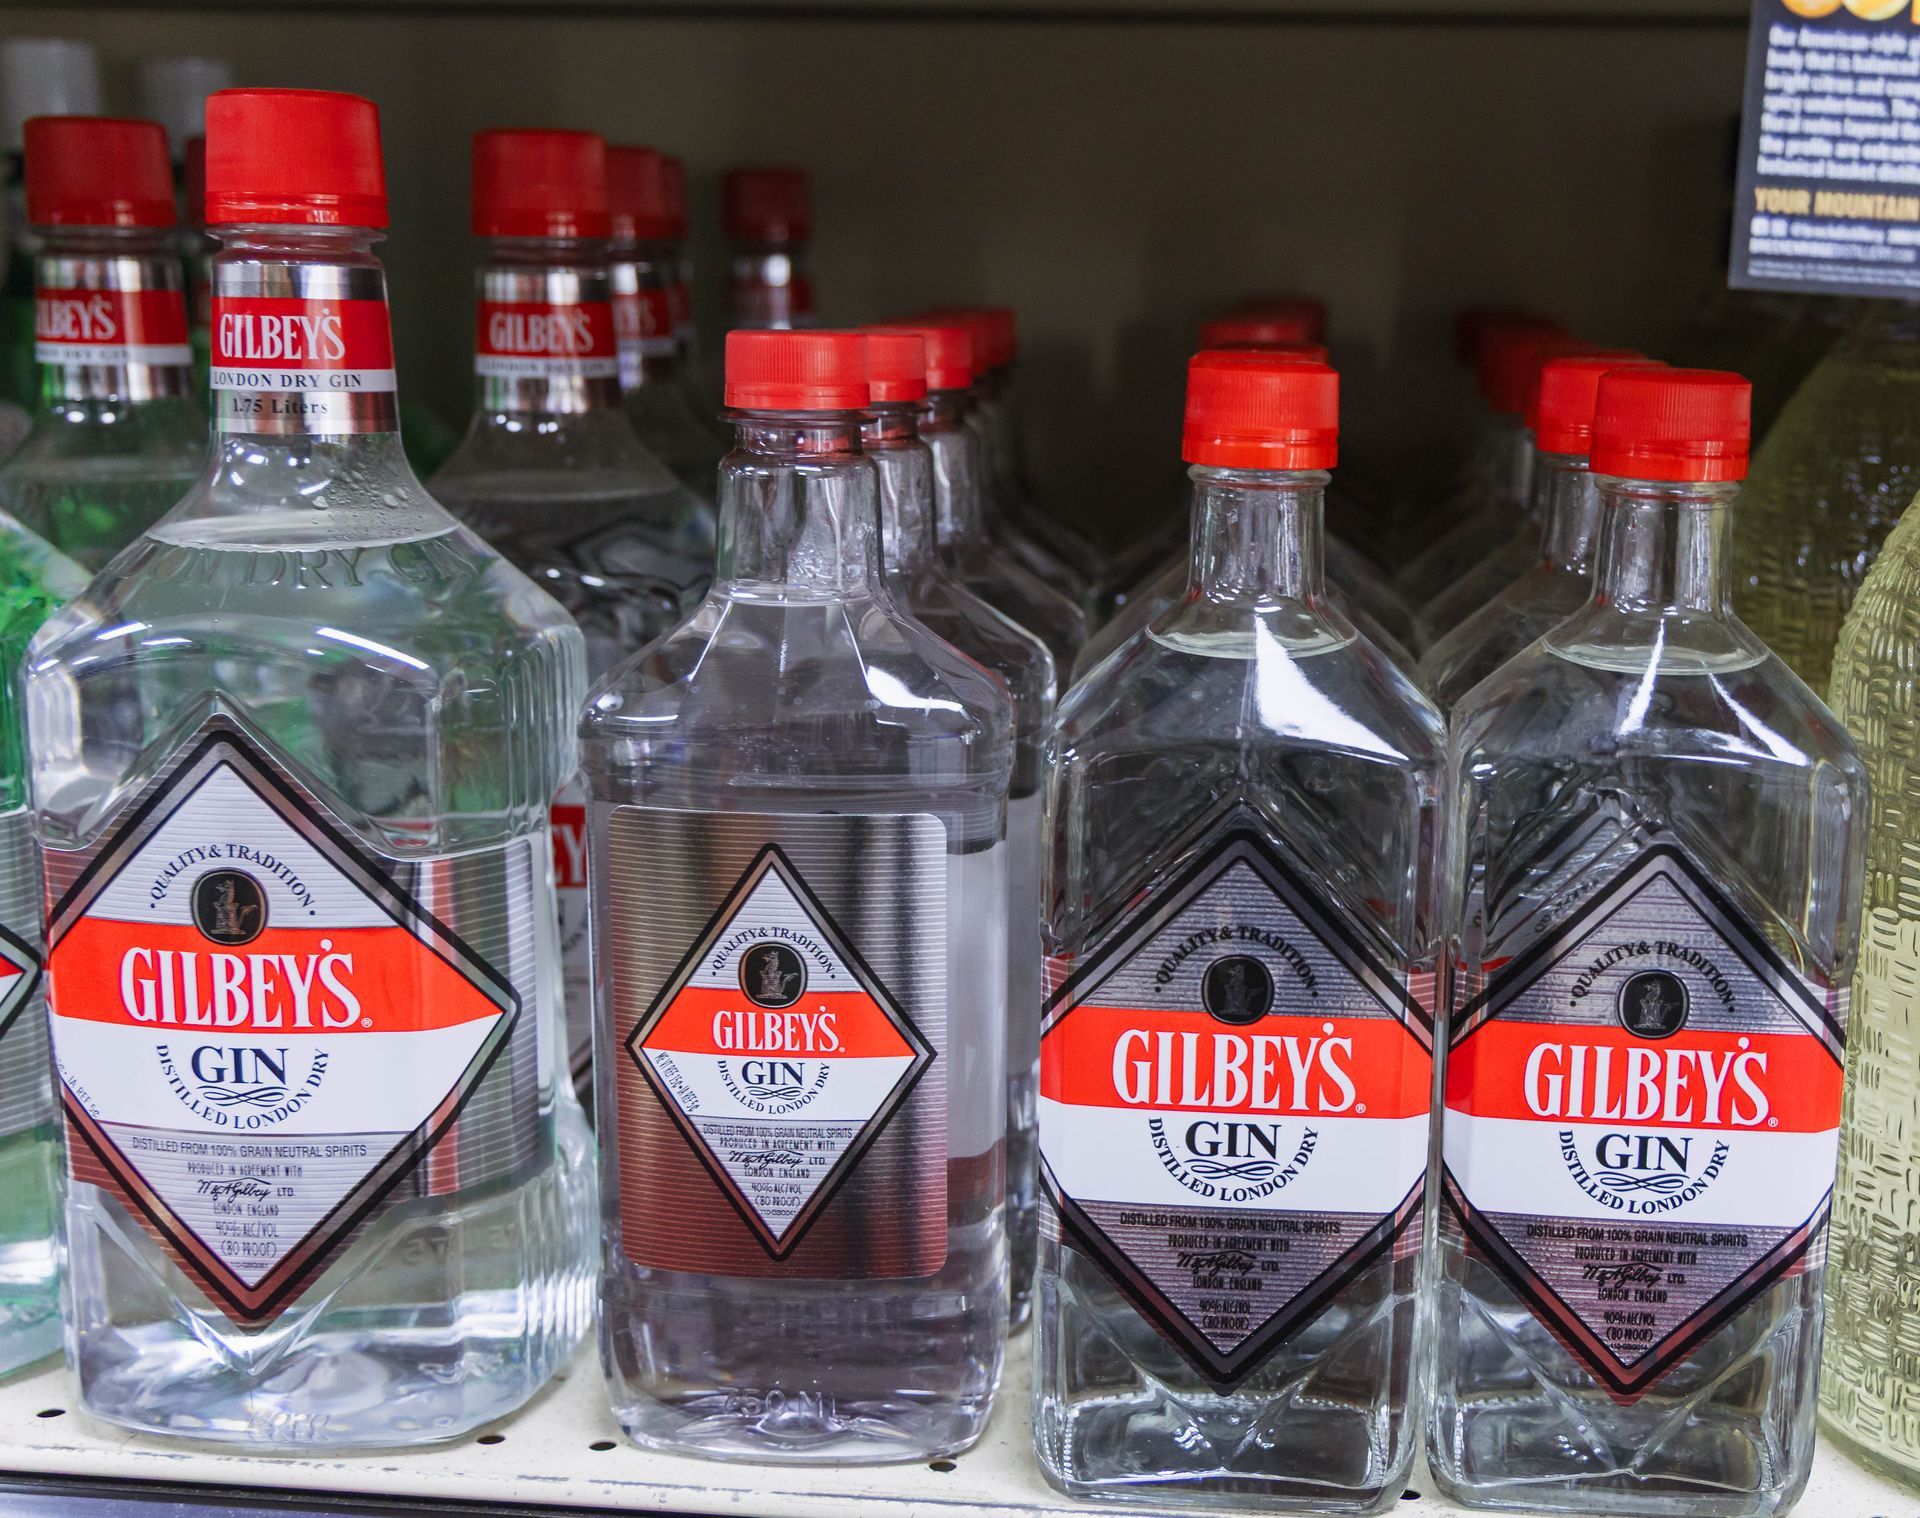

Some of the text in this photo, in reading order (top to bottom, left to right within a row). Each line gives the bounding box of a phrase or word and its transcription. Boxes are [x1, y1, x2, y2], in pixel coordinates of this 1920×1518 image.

[219, 307, 346, 361] GILBEY'S
[213, 372, 362, 388] LONDON DRY GIN
[233, 398, 328, 414] 1.75 Liters
[151, 844, 315, 907] QUALITY & TRADITION
[713, 927, 835, 973] QUALITY & TRADITION
[1156, 927, 1218, 984] QUALITY
[1236, 925, 1319, 989] TRADITION
[120, 938, 361, 1029] GILBEY'S
[1572, 943, 1635, 998] QUALITY
[1655, 940, 1736, 1005] TRADITION
[712, 1005, 840, 1052] GILBEY'S
[156, 1044, 329, 1129] DISTILLED LONDON DRY
[191, 1045, 289, 1085] GIN
[741, 1060, 806, 1086] GIN
[1112, 1022, 1356, 1113] GILBEY'S
[1524, 1037, 1769, 1126] GILBEY'S
[718, 1060, 830, 1114] DISTILLED LONDON DRY
[132, 1137, 367, 1158] DISTILLED FROM 100% GRAIN NEUTRAL SPIRITS
[703, 1124, 853, 1139] DISTILLED FROM 100% GRAIN NEUTRAL SPIRITS
[720, 1137, 835, 1151] PRODUCED IN AGREEMENT WITH
[1185, 1120, 1282, 1160] GIN
[1595, 1133, 1693, 1173] GIN
[187, 1162, 303, 1178] PRODUCED IN AGREEMENT WITH
[744, 1167, 810, 1178] LONDON ENGLAND
[1149, 1117, 1318, 1201] DISTILLED LONDON DRY
[1559, 1129, 1730, 1214] DISTILLED LONDON DRY
[213, 1204, 280, 1217] LONDON ENGLAND
[1527, 1224, 1748, 1247] DISTILLED FROM 100% GRAIN NEUTRAL SPIRITS
